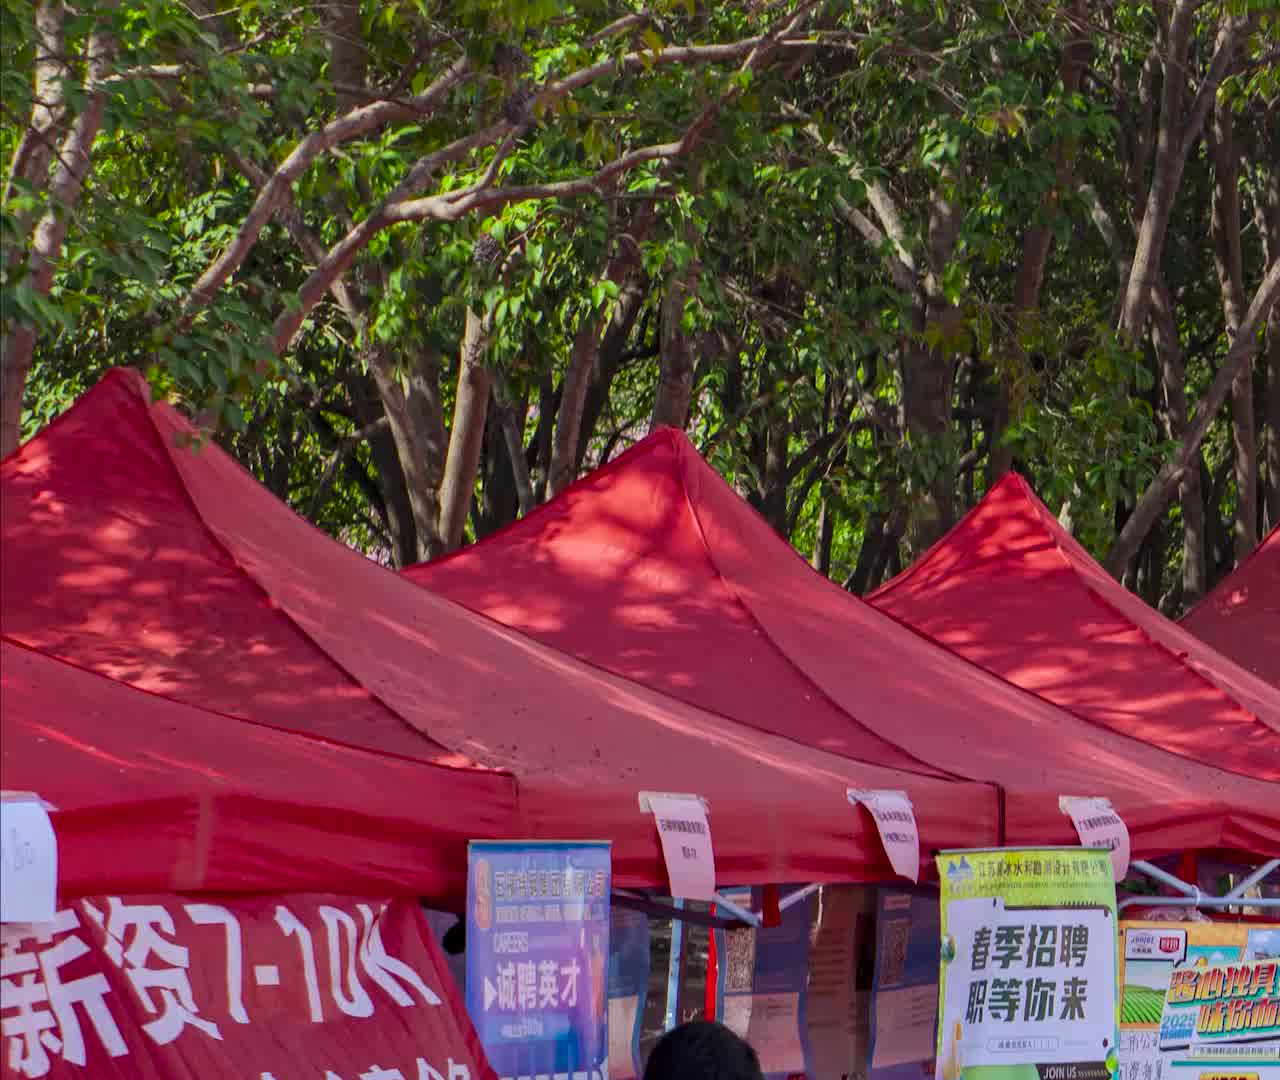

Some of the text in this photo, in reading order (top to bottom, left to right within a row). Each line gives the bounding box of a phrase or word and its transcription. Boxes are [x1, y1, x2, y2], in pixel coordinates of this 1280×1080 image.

[971, 924, 1089, 971] 春季招聘
[496, 957, 581, 1011] 诚聘英才
[965, 976, 1088, 1025] 职等你来
[1043, 1066, 1078, 1080] JOIN US
